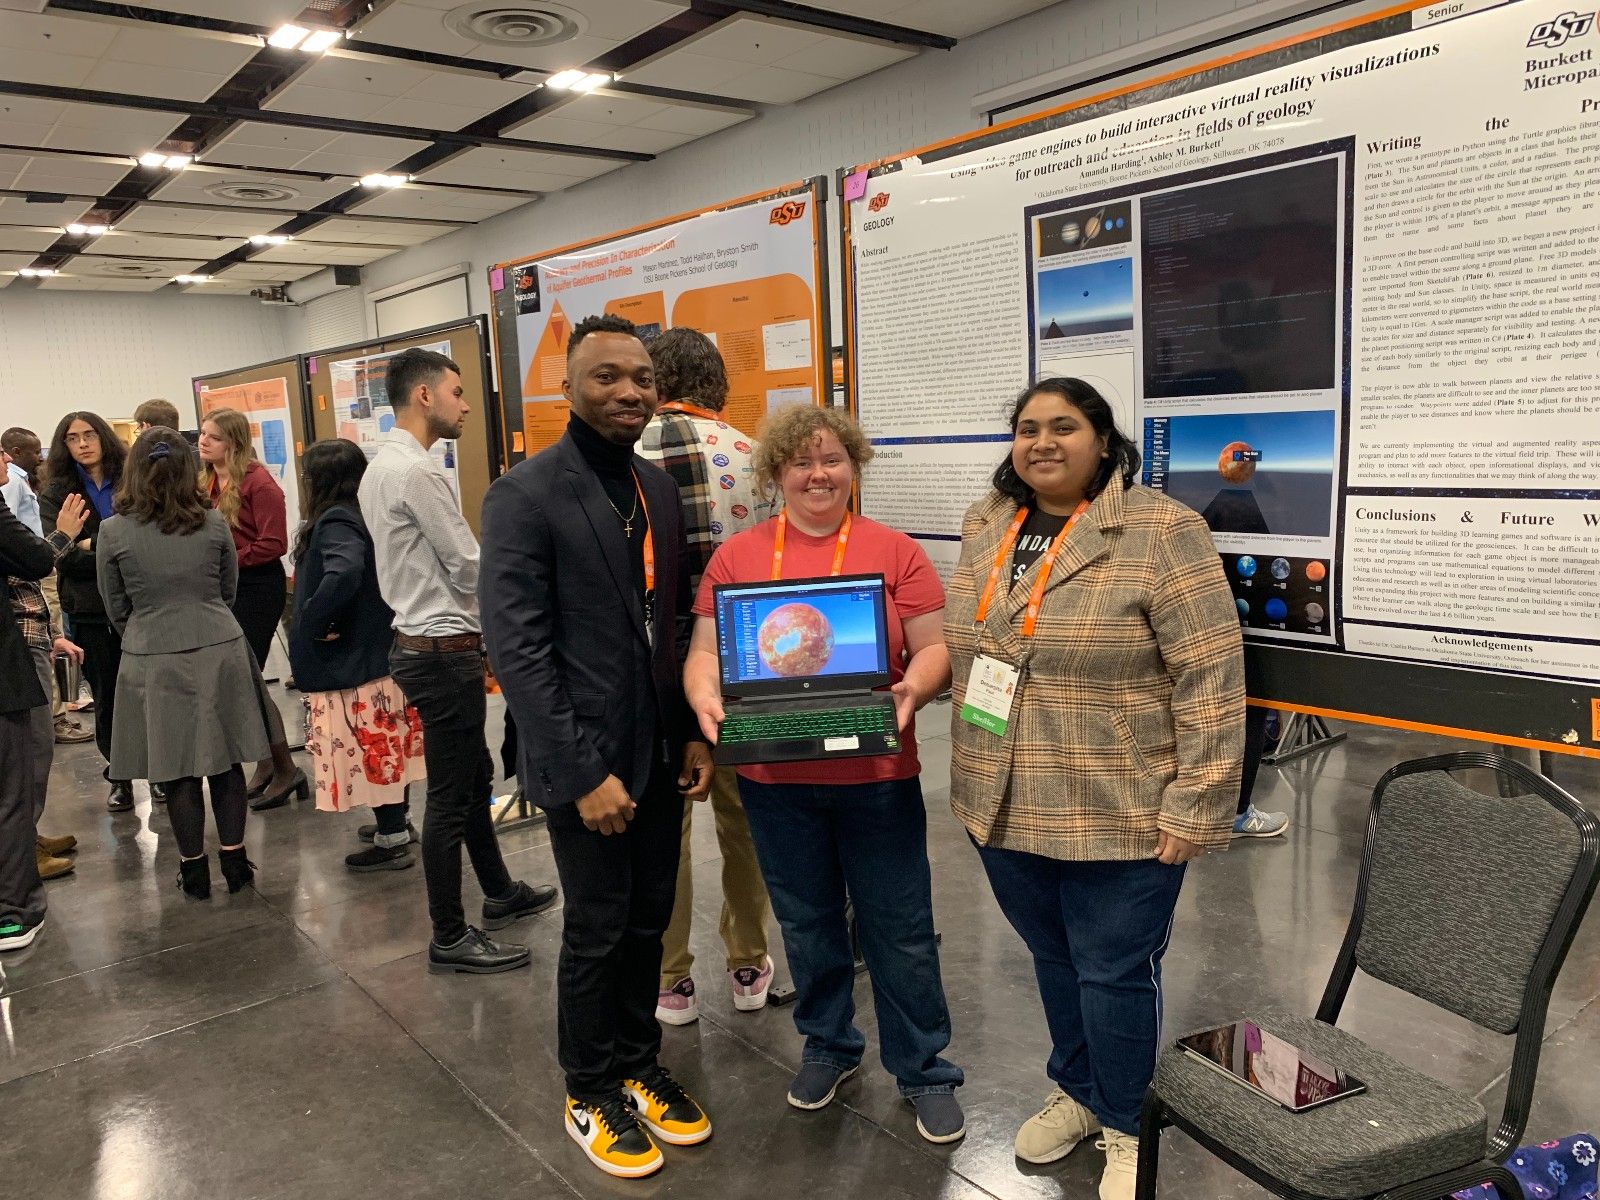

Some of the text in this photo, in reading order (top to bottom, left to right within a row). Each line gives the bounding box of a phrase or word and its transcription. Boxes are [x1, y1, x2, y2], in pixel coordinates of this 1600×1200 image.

[1427, 3, 1464, 20] Senior
[1525, 48, 1592, 73] Burkett
[1009, 149, 1037, 167] game
[1041, 137, 1082, 156] engines
[1085, 132, 1096, 144] to
[1100, 121, 1132, 140] build
[1135, 104, 1207, 131] interactive
[1211, 86, 1260, 111] virtual
[1264, 73, 1315, 99] reality
[1320, 43, 1441, 83] visualizations
[1580, 99, 1600, 113] Pr
[1485, 117, 1509, 131] the
[1016, 169, 1031, 181] for
[1034, 155, 1083, 177] outreach
[1086, 147, 1108, 164] and
[1178, 128, 1191, 142] in
[1196, 118, 1233, 138] fields
[1238, 110, 1254, 127] of
[1256, 98, 1316, 126] geology
[1367, 136, 1421, 154] Writing
[1462, 142, 1486, 152] Python
[1489, 138, 1506, 146] using
[1523, 131, 1543, 139] Turtle
[1546, 125, 1576, 135] graphics
[1037, 188, 1064, 199] Oklahoma
[1065, 184, 1078, 193] State
[1110, 174, 1128, 183] Boone
[1129, 170, 1152, 179] Pickens
[1153, 161, 1174, 173] School
[1175, 159, 1182, 168] of
[1183, 155, 1211, 166] Geology,
[1213, 147, 1247, 159] Stillwater,
[1248, 144, 1260, 152] OK
[1263, 137, 1285, 148] 74078
[1080, 166, 1109, 179] Amanda
[1148, 150, 1173, 163] Ashley
[1177, 148, 1186, 156] M.
[769, 201, 806, 226] OSU
[863, 216, 895, 232] GEOLOGY
[680, 255, 693, 265] Todd
[716, 245, 740, 259] Bryston
[740, 242, 759, 253] Smith
[861, 246, 889, 258] Abstract
[552, 279, 572, 293] Aquifer
[572, 271, 607, 288] Geothermal
[608, 265, 633, 279] Profiles
[643, 258, 738, 284] OSU Boone Pickens School of Geology
[1513, 440, 1550, 448] augmented
[1356, 507, 1600, 527] Conclusions & Future W
[1431, 529, 1457, 538] building
[1466, 551, 1481, 559] each
[1484, 554, 1502, 562] game
[1506, 554, 1527, 562] object
[1430, 634, 1533, 652] Acknowledgements
